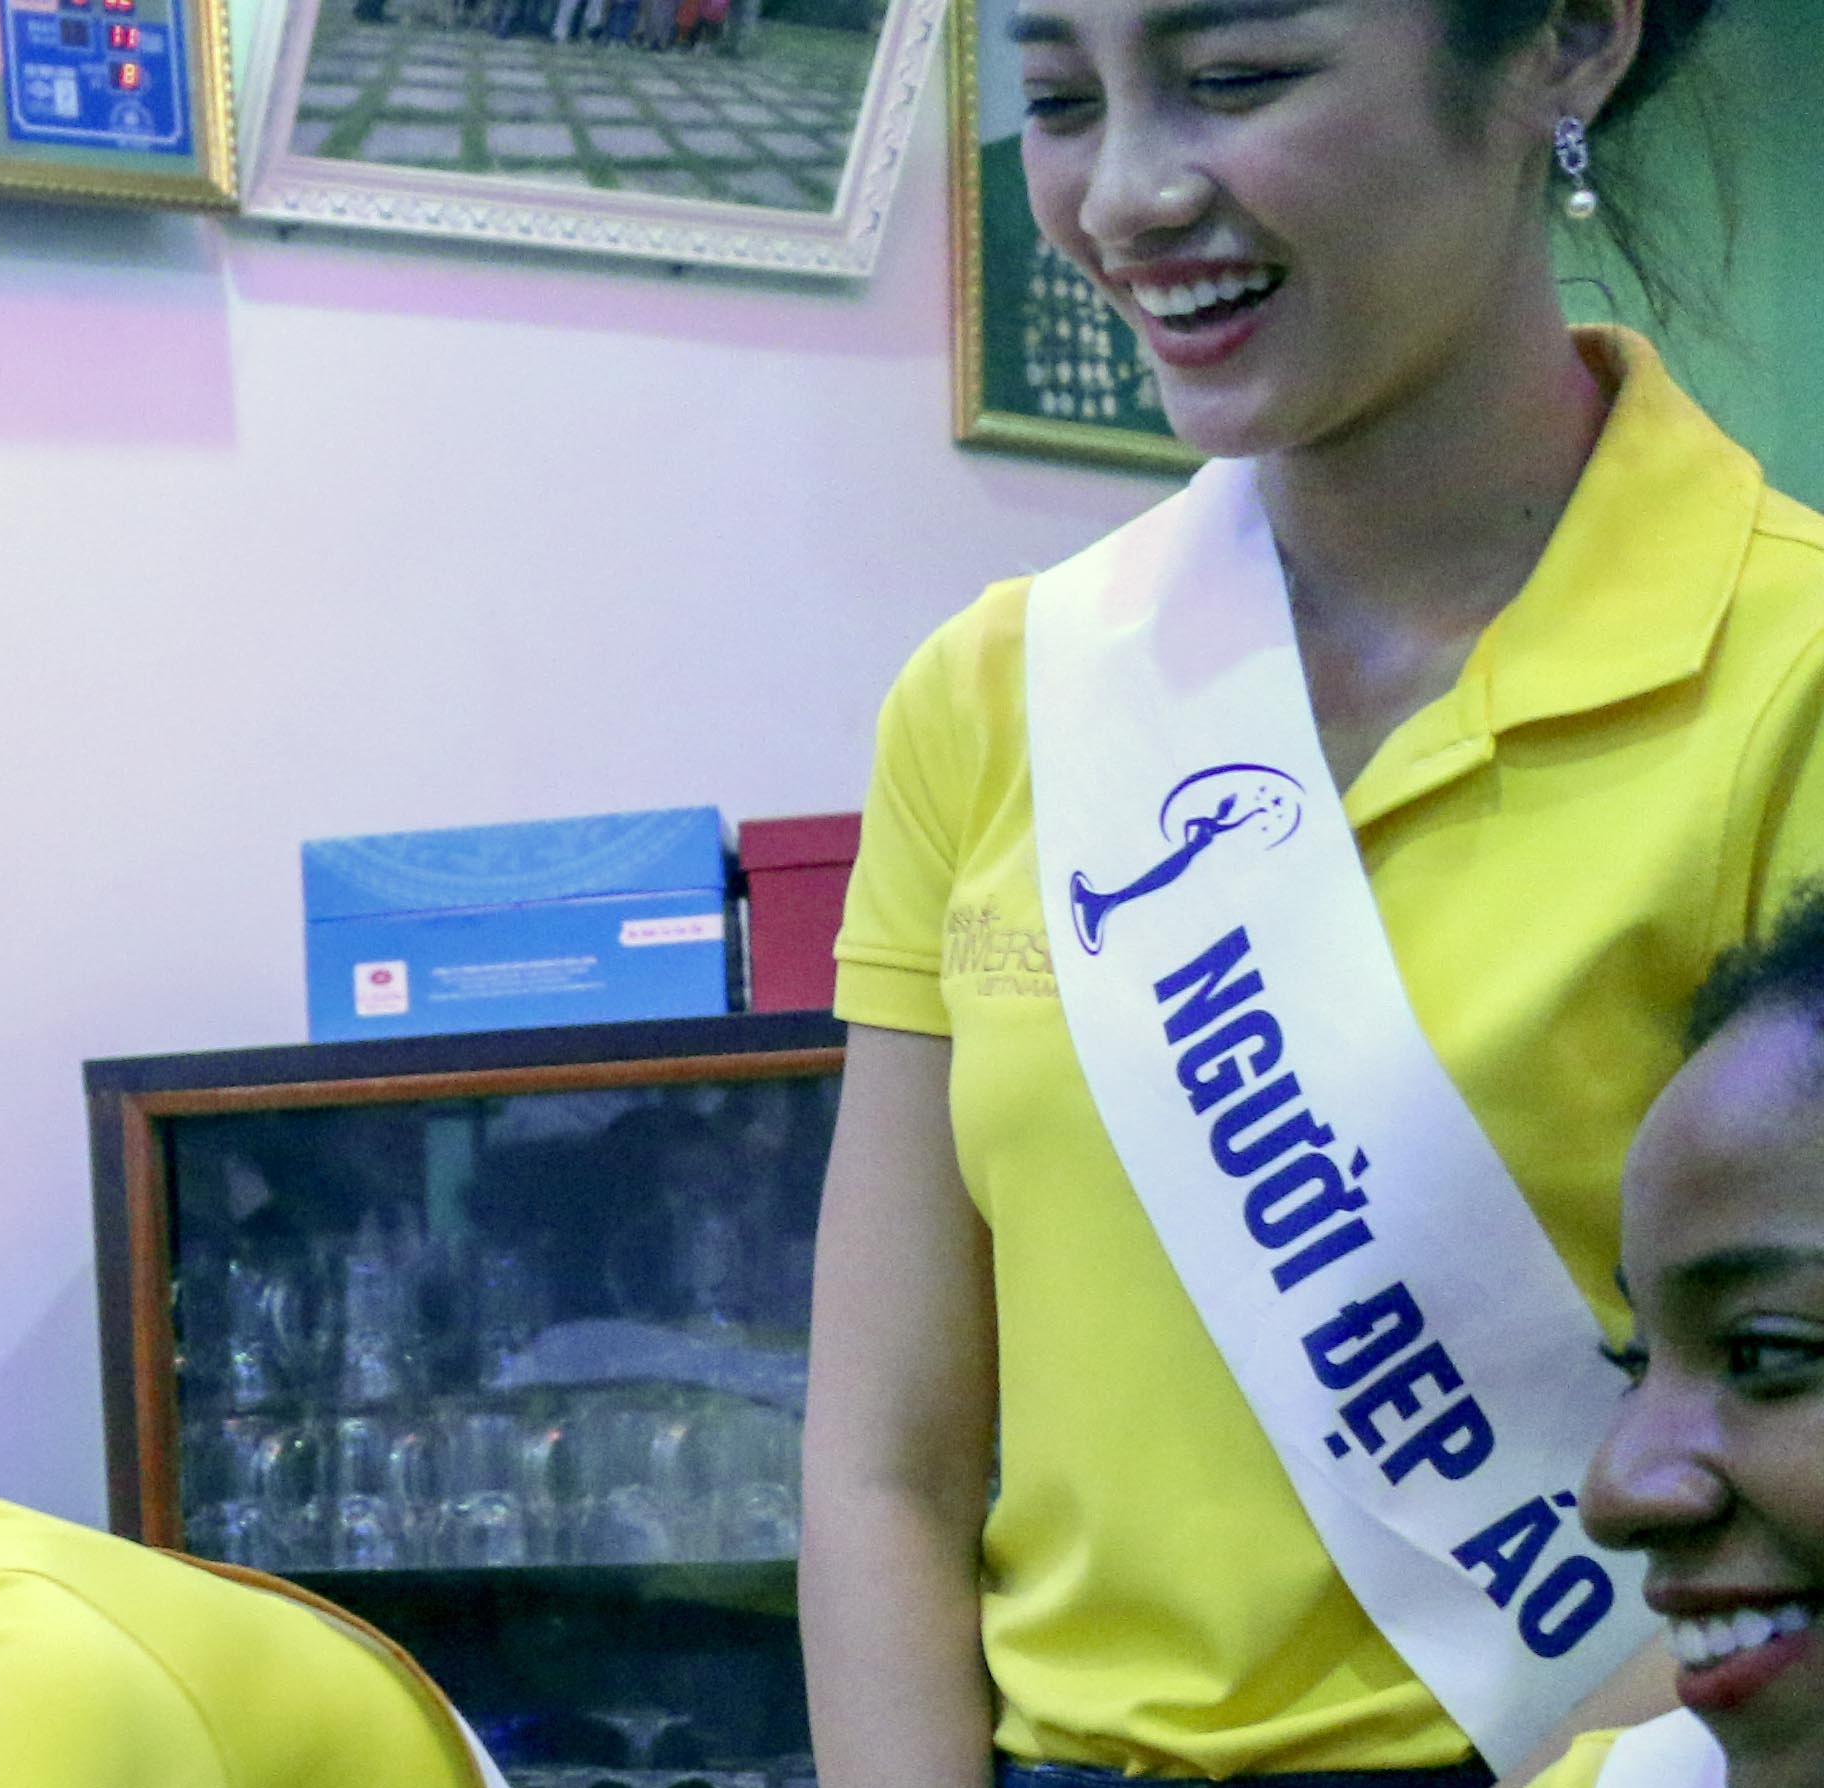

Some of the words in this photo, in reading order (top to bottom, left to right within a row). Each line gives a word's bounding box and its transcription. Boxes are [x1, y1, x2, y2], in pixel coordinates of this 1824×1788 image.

[1153, 925, 1376, 1295] NGƯỜI
[1300, 1280, 1497, 1486] ĐẸP
[1450, 1490, 1616, 1659] ÁO
